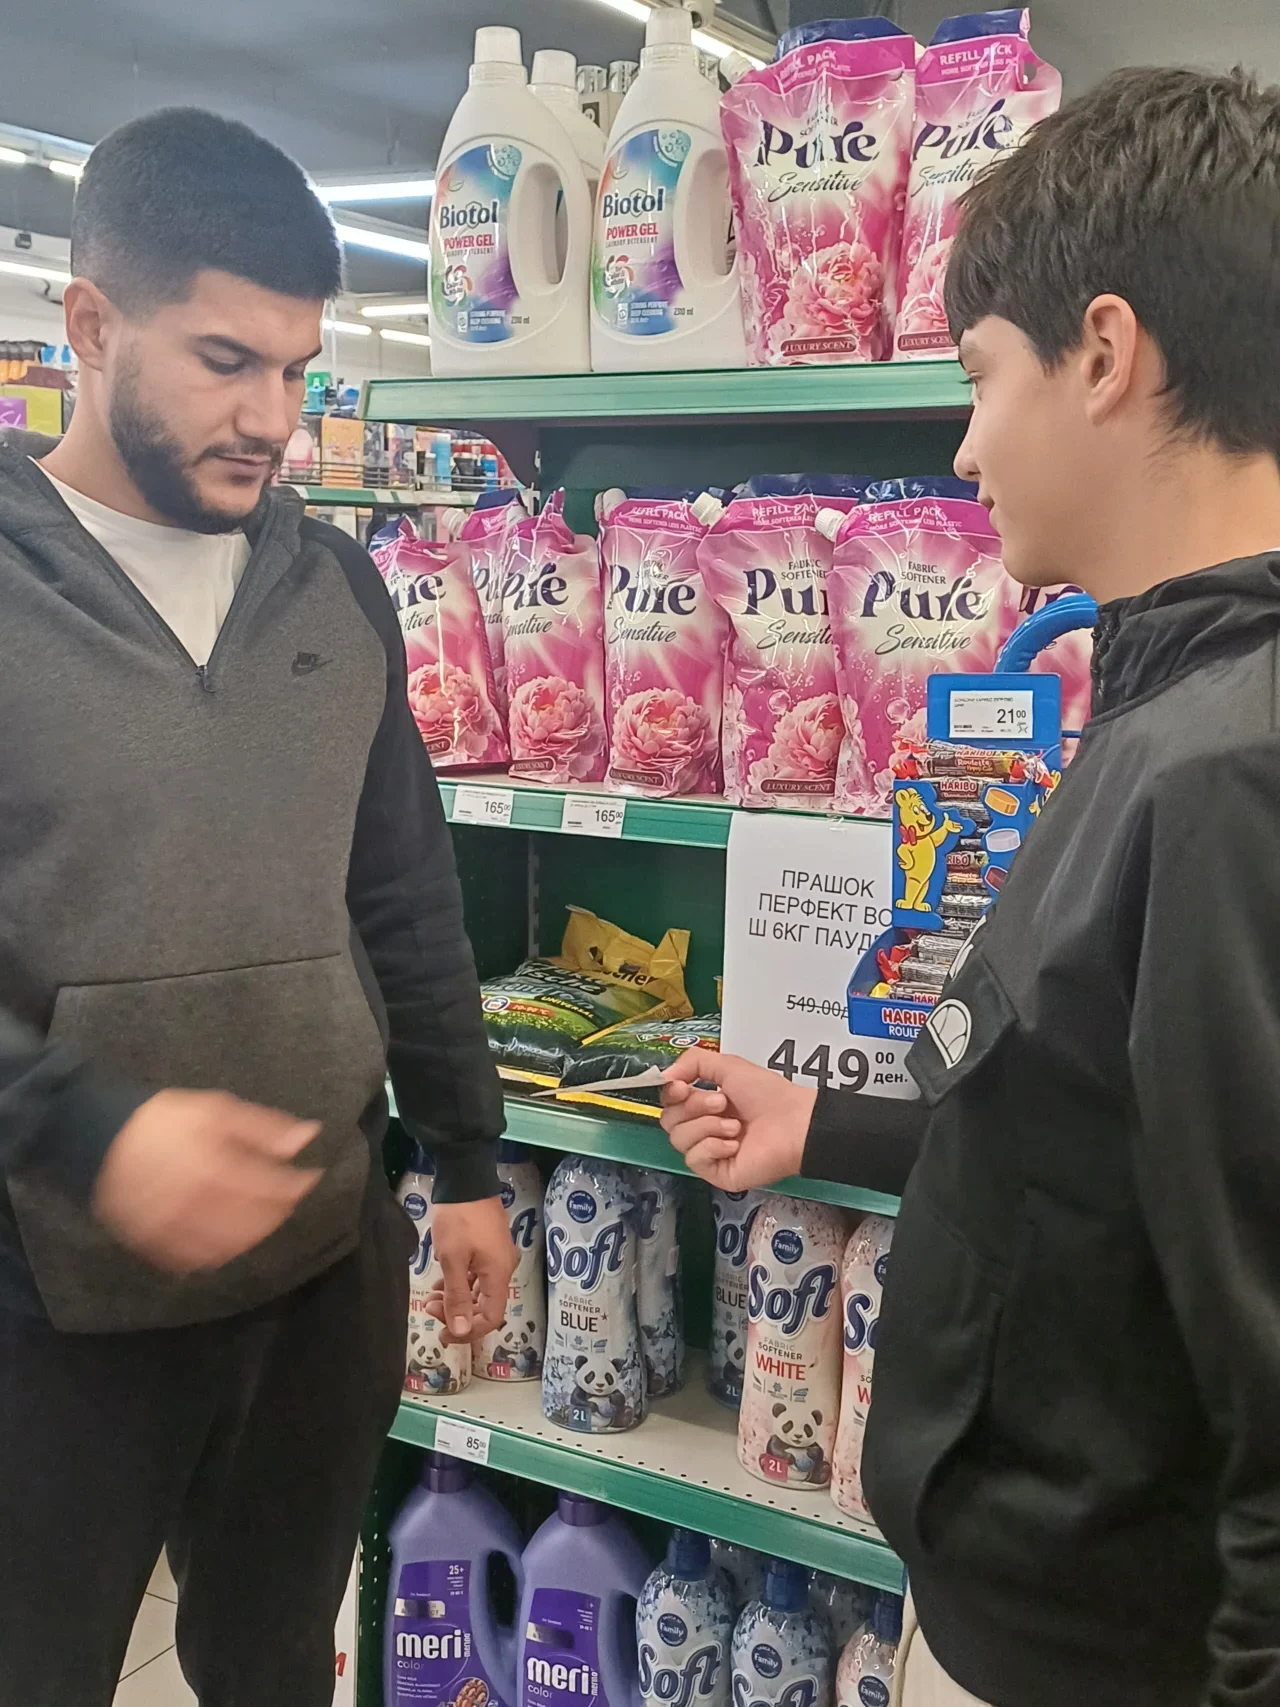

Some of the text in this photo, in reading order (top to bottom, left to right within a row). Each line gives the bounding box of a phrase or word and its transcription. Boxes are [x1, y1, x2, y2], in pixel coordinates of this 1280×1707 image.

[940, 50, 981, 66] REFILL
[753, 121, 880, 169] Pure
[602, 188, 664, 218] Biotol
[440, 201, 498, 229] Biotol
[606, 223, 658, 240] POWER GEL
[444, 234, 495, 250] POWER GEL
[822, 340, 852, 350] SCENT
[930, 335, 951, 345] SCEN
[662, 509, 684, 520] PACK
[868, 505, 941, 523] REFILL PACK
[908, 561, 938, 573] FABRIC
[901, 571, 947, 584] SOFTENER
[609, 565, 697, 615] Pure
[860, 571, 989, 621] Pure
[608, 617, 677, 644] Sensitive
[875, 624, 972, 655] Sensitive
[996, 708, 1027, 724] 21 00
[426, 741, 446, 752] CENT
[635, 776, 660, 785] SCENT
[766, 783, 832, 791] LUXURY SCENT
[941, 780, 977, 792] HARIBO
[485, 800, 504, 815] 165
[595, 809, 623, 823] 165 00
[946, 855, 968, 865] RIBO
[781, 869, 875, 899] ПРАШОК
[758, 892, 858, 923] ПЕРФЕКТ
[748, 917, 767, 938] Ш
[772, 921, 810, 943] 6КГ
[914, 993, 940, 1004] HARI
[541, 996, 595, 1018] UNIVERSAL
[882, 1008, 930, 1028] HARIB
[767, 1039, 895, 1093] 449 00
[873, 1071, 908, 1084] ден.
[569, 1200, 594, 1213] Family
[773, 1239, 800, 1254] Family
[548, 1221, 627, 1290] Soft
[564, 1294, 593, 1306] FABRIC
[715, 1286, 747, 1310] BLUE
[748, 1264, 836, 1334] Soft
[559, 1299, 600, 1314] SOFTENER
[560, 1310, 598, 1333] BLUE
[758, 1341, 803, 1360] SOFTENER
[764, 1336, 795, 1351] FABRIC
[496, 1365, 506, 1376] 1L
[755, 1350, 807, 1380] WHITE
[411, 1378, 419, 1390] 1L
[725, 1384, 738, 1397] 2L
[572, 1409, 587, 1422] 2L
[466, 1436, 480, 1450] 85
[768, 1459, 782, 1473] 2L
[448, 1565, 464, 1575] 25+
[659, 1622, 684, 1637] Family
[397, 1629, 462, 1659] meri
[754, 1654, 779, 1668] Family
[526, 1657, 590, 1695] meri
[640, 1644, 723, 1707] Soft
[528, 1684, 553, 1699] color
[860, 1684, 886, 1702] Family
